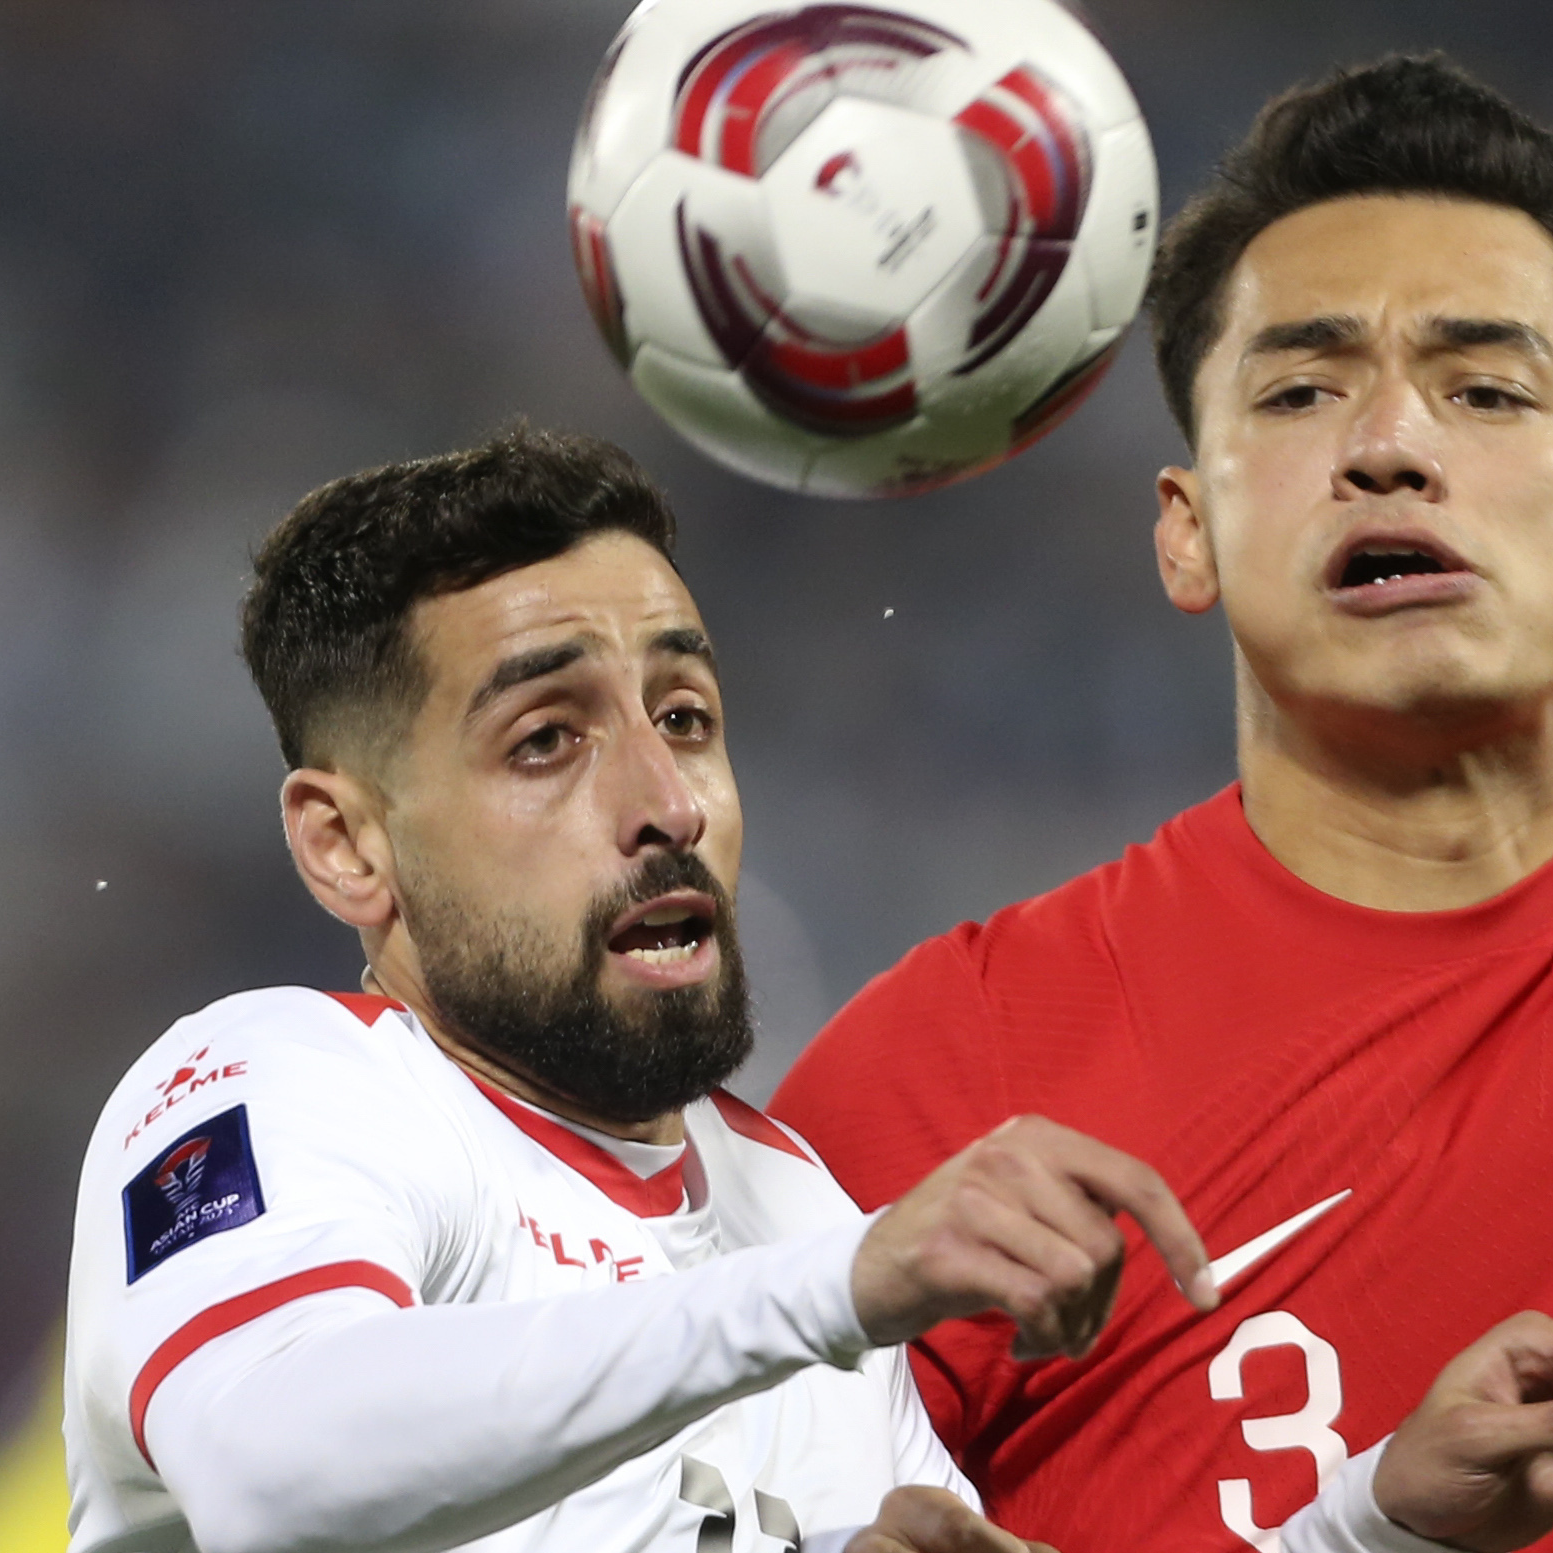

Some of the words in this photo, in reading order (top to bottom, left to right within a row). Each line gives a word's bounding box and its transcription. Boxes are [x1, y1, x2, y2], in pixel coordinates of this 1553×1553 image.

[124, 1060, 247, 1151] KELME
[149, 1210, 197, 1253] ASIAN
[199, 1193, 240, 1215] CUP
